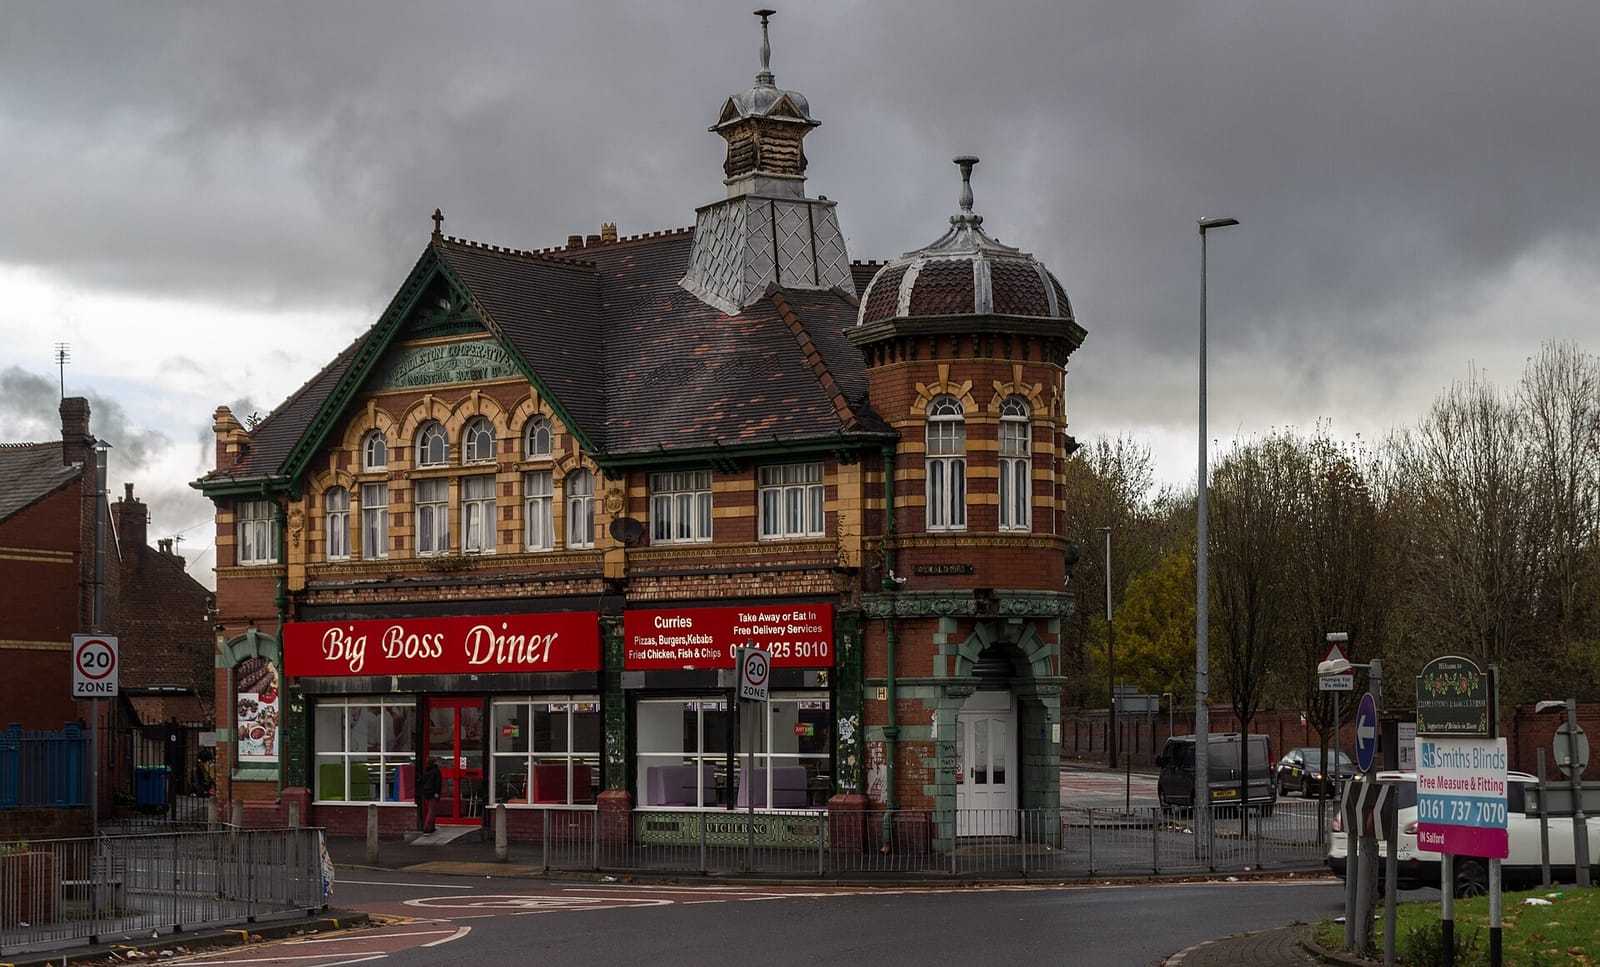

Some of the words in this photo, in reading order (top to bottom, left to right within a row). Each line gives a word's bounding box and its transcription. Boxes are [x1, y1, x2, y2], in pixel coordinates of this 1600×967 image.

[654, 615, 692, 629] Curries
[738, 613, 757, 622] Take
[758, 612, 780, 623] Away
[782, 613, 791, 621] or
[793, 611, 807, 620] Eat
[808, 611, 817, 620] In
[733, 625, 751, 635] Free
[752, 625, 785, 636] Delivery
[787, 624, 822, 634] Services
[322, 625, 367, 673] Big
[381, 625, 445, 659] Boss
[465, 622, 559, 665] Diner
[634, 635, 658, 647] Pizzas,
[628, 649, 646, 659] Fried
[647, 649, 677, 660] Chicken,
[677, 648, 693, 659] Fish
[694, 647, 700, 658] &
[701, 647, 721, 660] Chips
[766, 641, 791, 658] 425
[795, 641, 828, 658] 5010
[83, 651, 110, 668] 20
[748, 661, 765, 677] 20
[77, 682, 113, 692] ZONE
[743, 685, 765, 698] ZONE
[1437, 747, 1470, 768] Smiths
[1473, 747, 1505, 770] Blinds
[1420, 775, 1435, 789] Free
[1437, 776, 1469, 791] Measure
[1470, 777, 1476, 790] &
[1477, 777, 1504, 796] Fitting
[1420, 799, 1444, 819] 0161
[1451, 801, 1471, 821] 737
[1477, 802, 1504, 824] 7070
[1426, 832, 1444, 844] Salford
